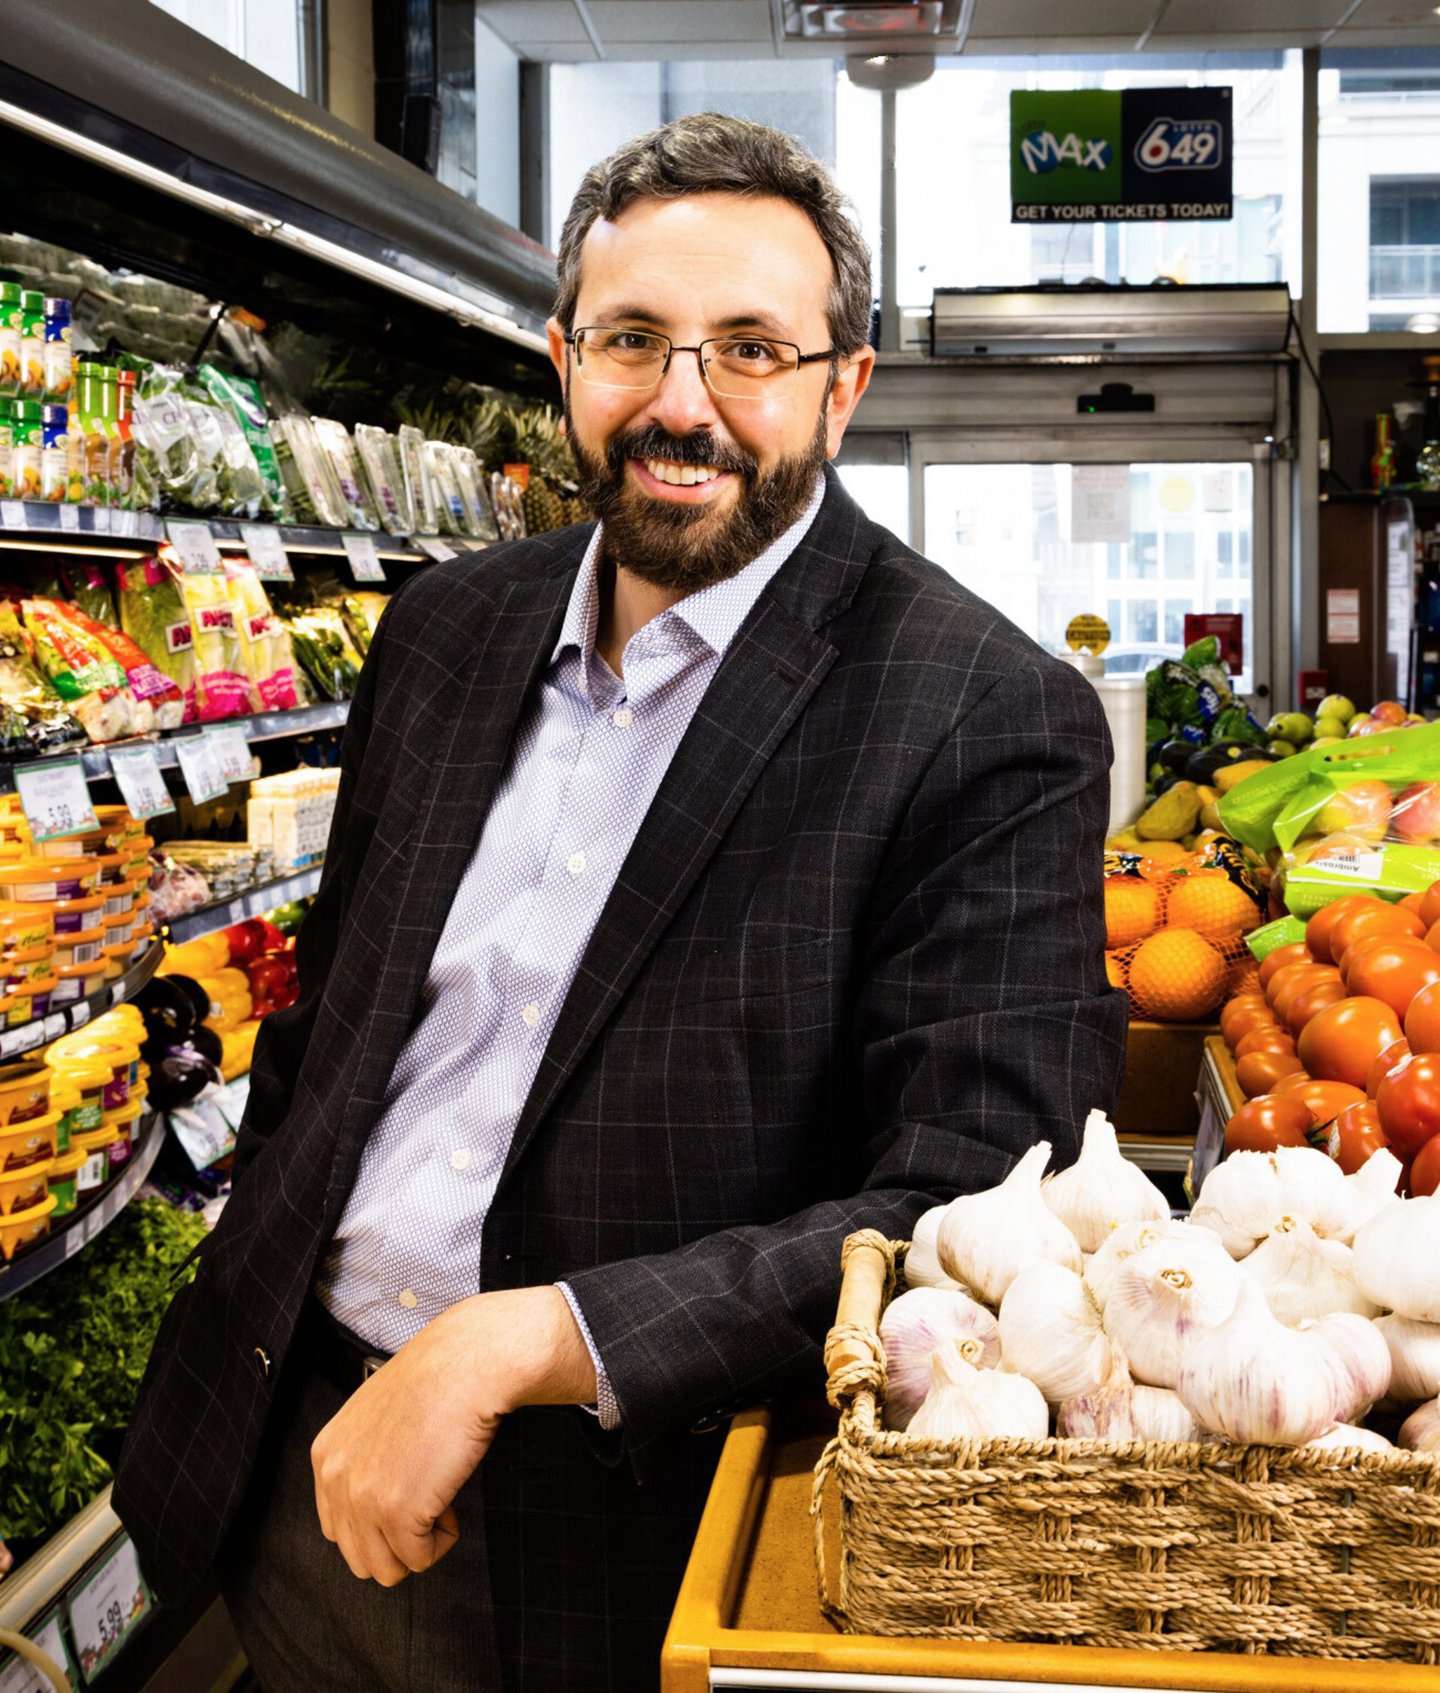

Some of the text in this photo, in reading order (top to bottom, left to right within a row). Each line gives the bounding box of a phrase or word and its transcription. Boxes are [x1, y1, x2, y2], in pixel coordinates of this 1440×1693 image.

[1016, 203, 1229, 219] GET YOUR TICKETS TODAY!
